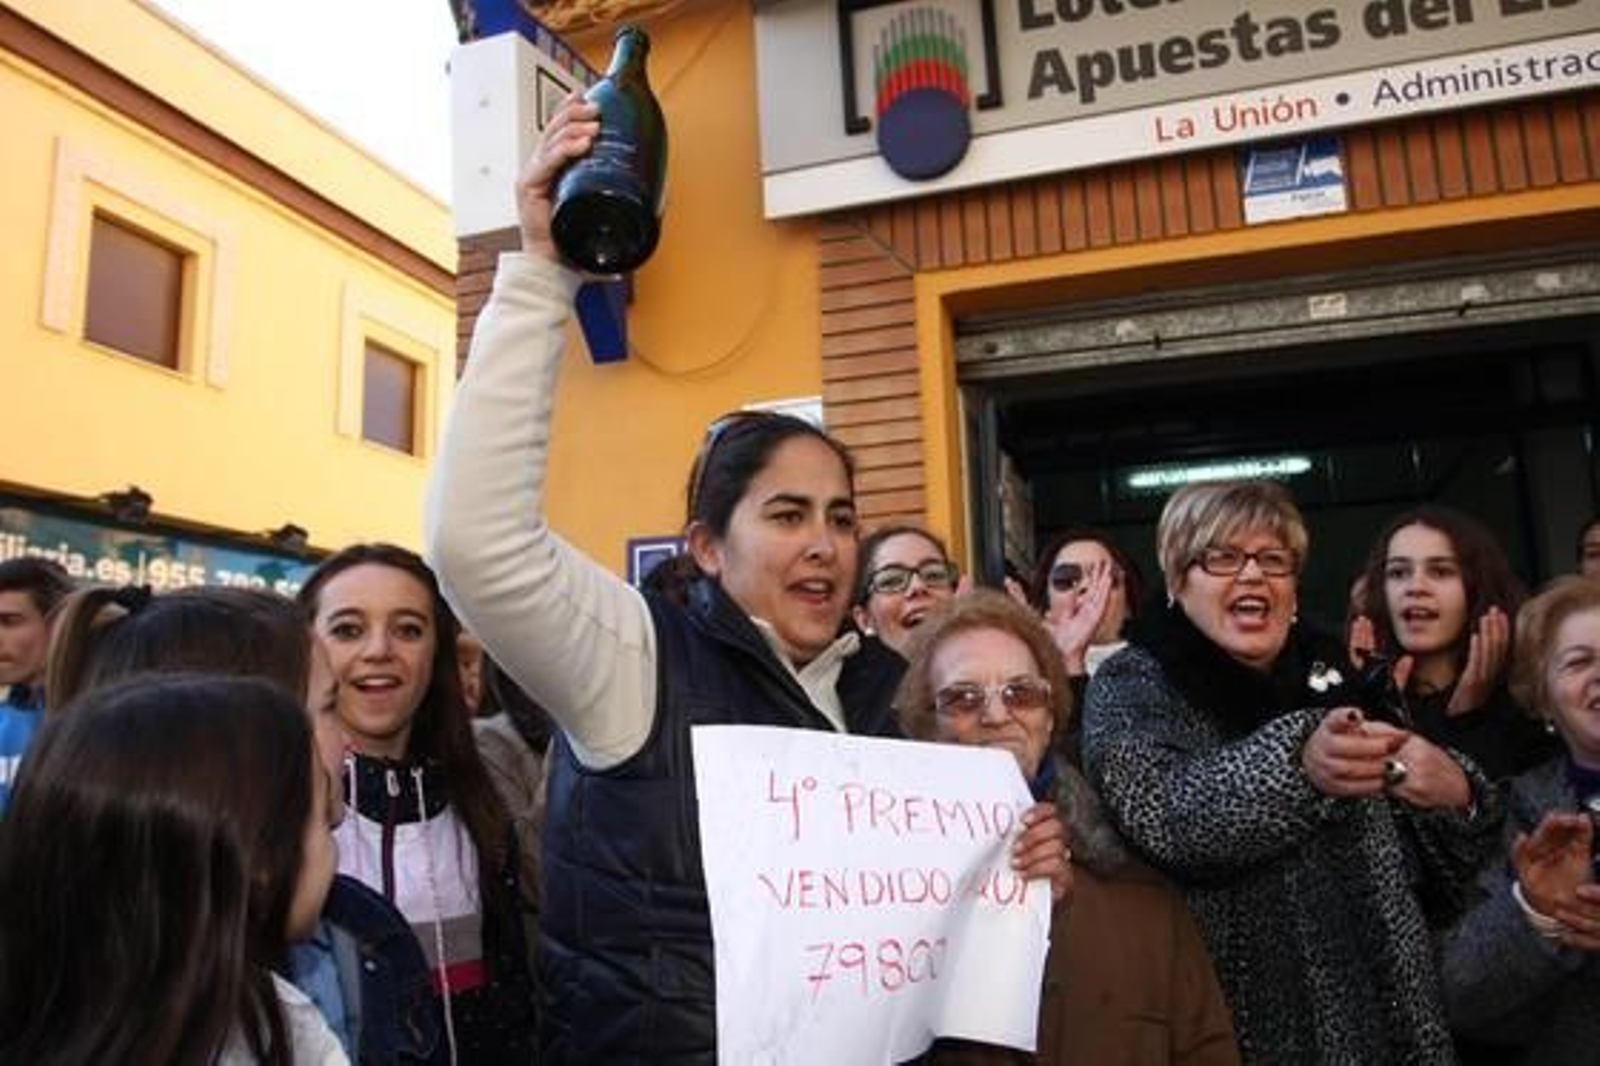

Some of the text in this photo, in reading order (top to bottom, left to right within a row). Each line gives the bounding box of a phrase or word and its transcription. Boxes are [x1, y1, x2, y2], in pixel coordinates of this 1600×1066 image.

[1027, 8, 1341, 104] Apuestas
[1155, 116, 1195, 142] La
[1213, 95, 1317, 132] Unión
[838, 782, 1014, 840] PREMIO
[757, 867, 951, 908] VENDIDO
[804, 937, 947, 1005] 7980
